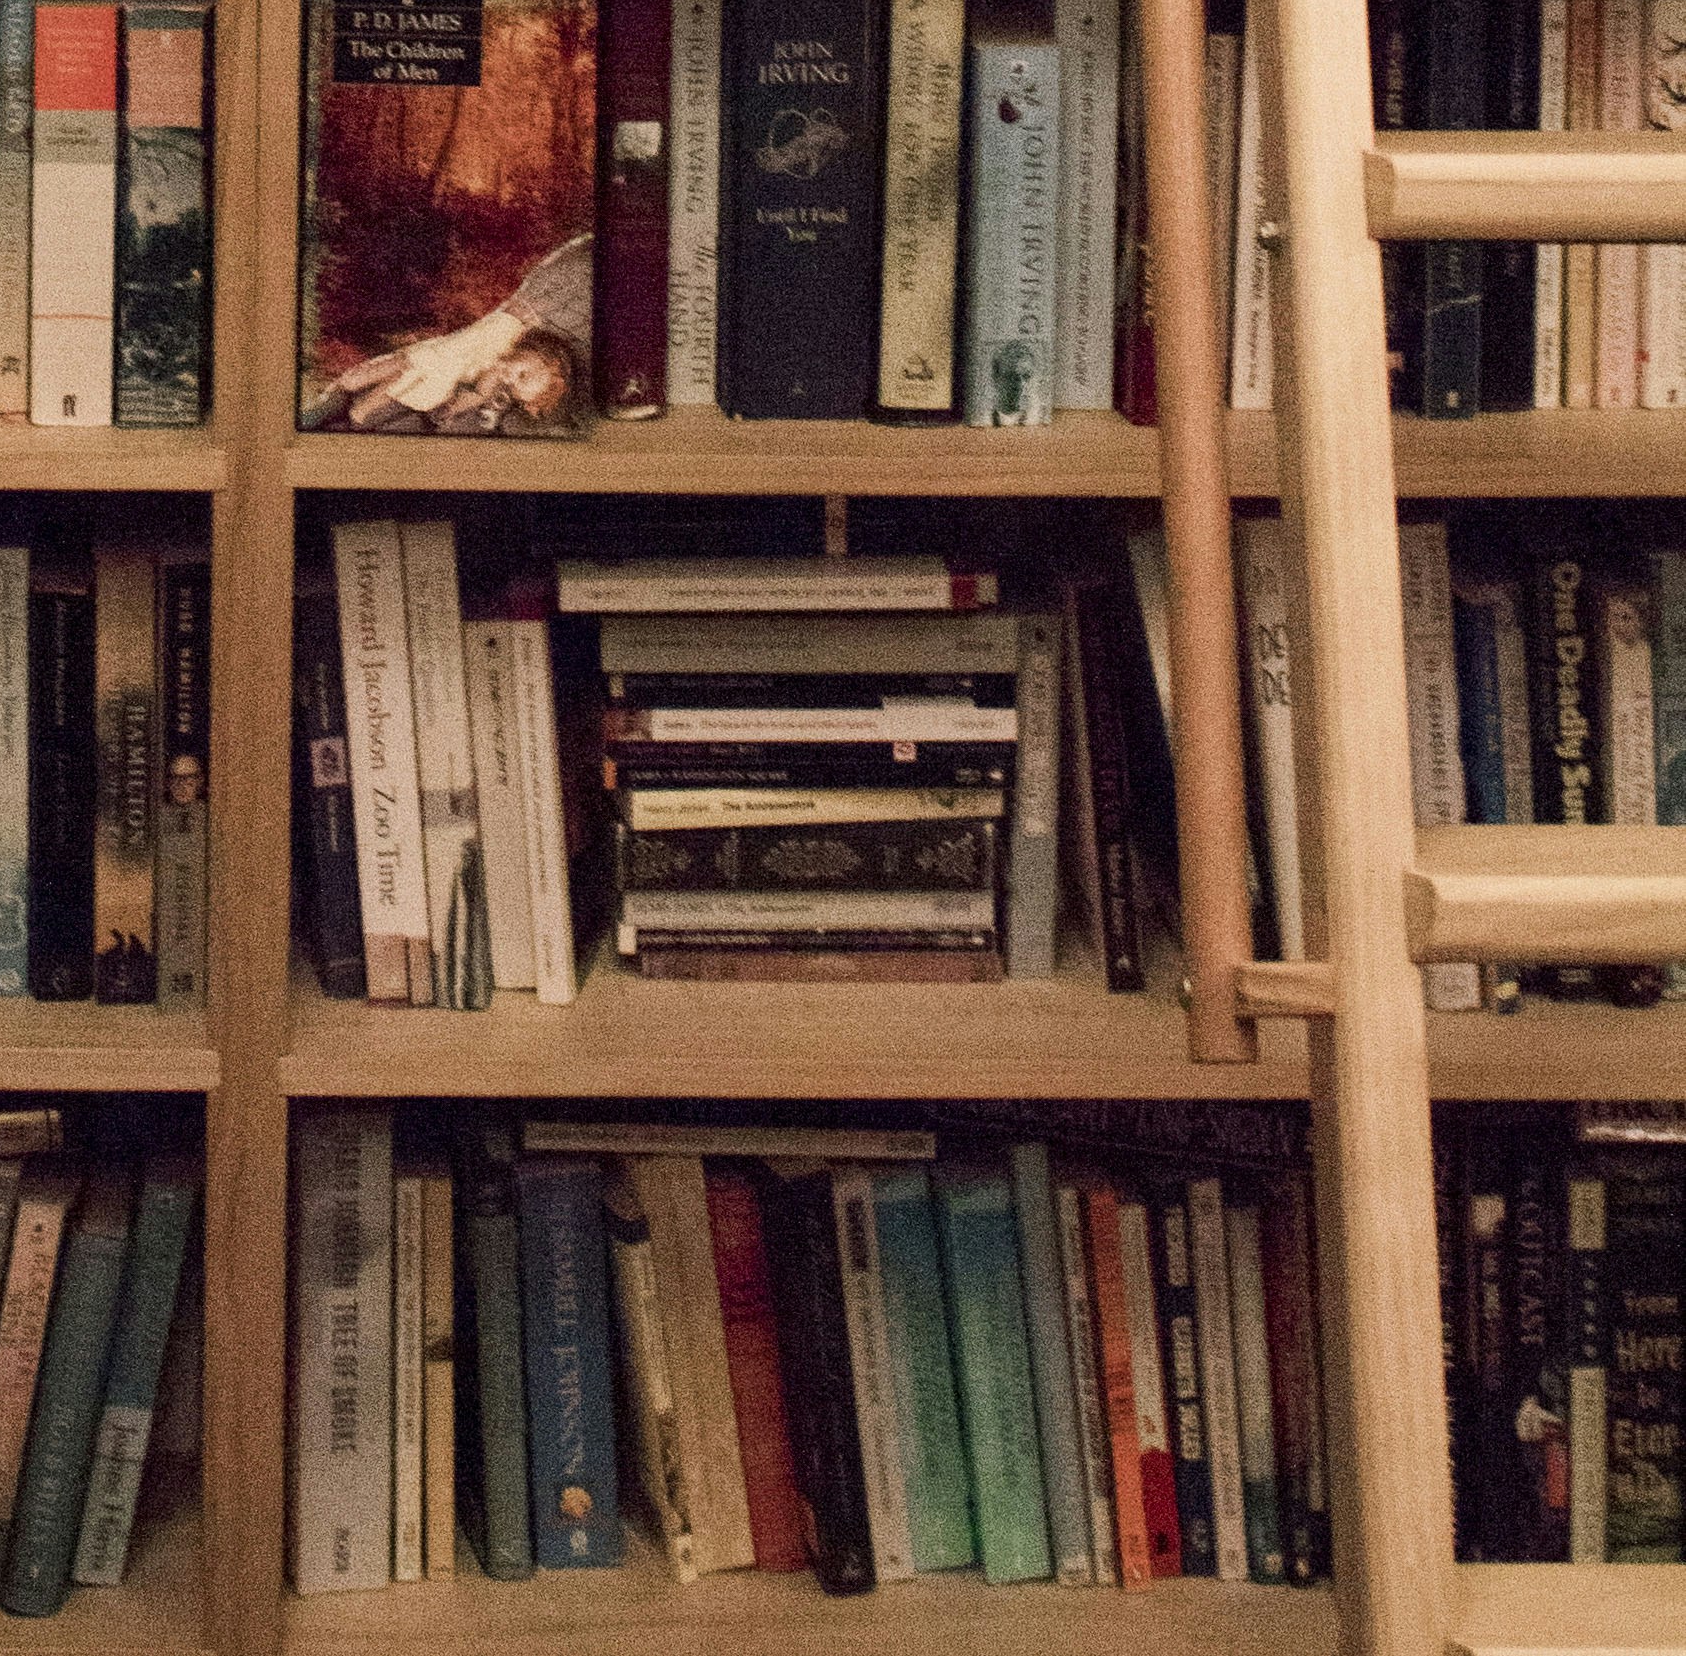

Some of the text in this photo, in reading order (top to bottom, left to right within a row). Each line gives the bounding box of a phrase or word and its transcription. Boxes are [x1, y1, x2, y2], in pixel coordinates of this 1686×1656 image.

[758, 61, 850, 85] IRVING
[773, 41, 835, 60] JOHN
[1021, 124, 1046, 341] JOHN IRVING
[1551, 560, 1582, 632] One
[357, 547, 401, 908] Howard Jacobson Zoo Time
